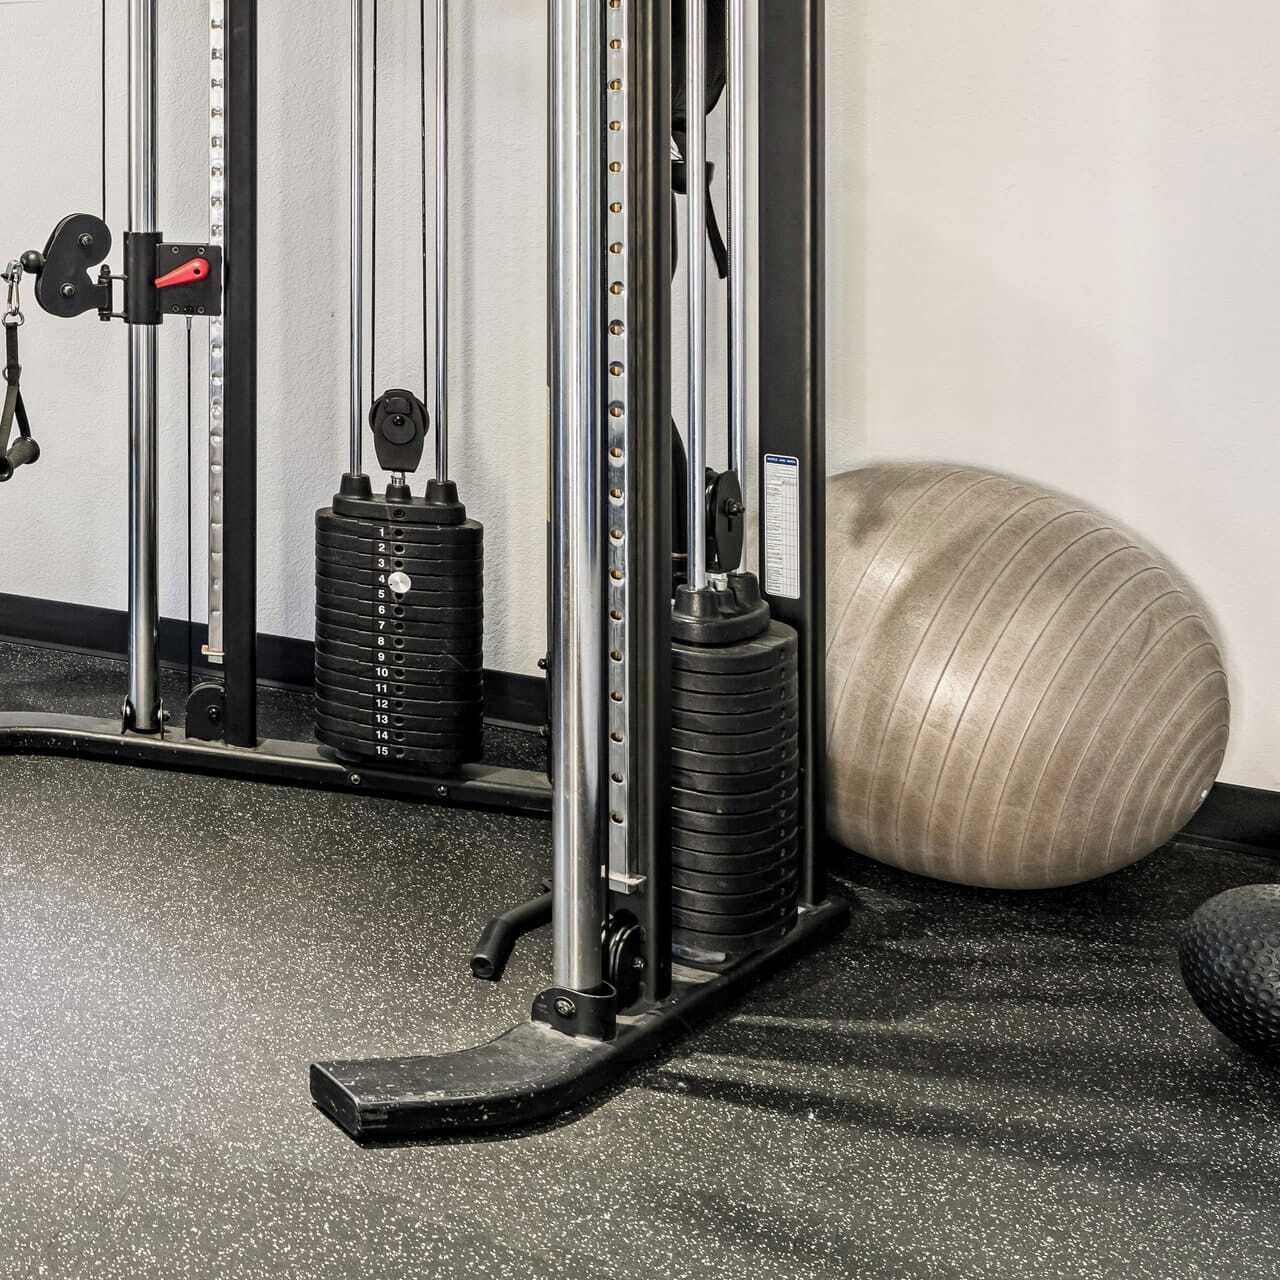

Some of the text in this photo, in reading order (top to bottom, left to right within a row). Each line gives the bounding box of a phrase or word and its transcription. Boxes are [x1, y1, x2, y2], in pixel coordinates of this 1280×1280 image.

[379, 527, 384, 536] 1
[378, 543, 385, 552] 2
[378, 559, 385, 567] 3
[378, 575, 385, 583] 4
[378, 590, 385, 598] 5
[378, 605, 385, 614] 6
[378, 621, 385, 630] 7
[378, 637, 385, 645] 8
[378, 652, 385, 661] 9
[376, 667, 389, 677] 10
[376, 683, 388, 693] 11
[376, 699, 389, 708] 12
[376, 714, 389, 724] 13
[376, 730, 389, 740] 14
[376, 746, 389, 755] 15
